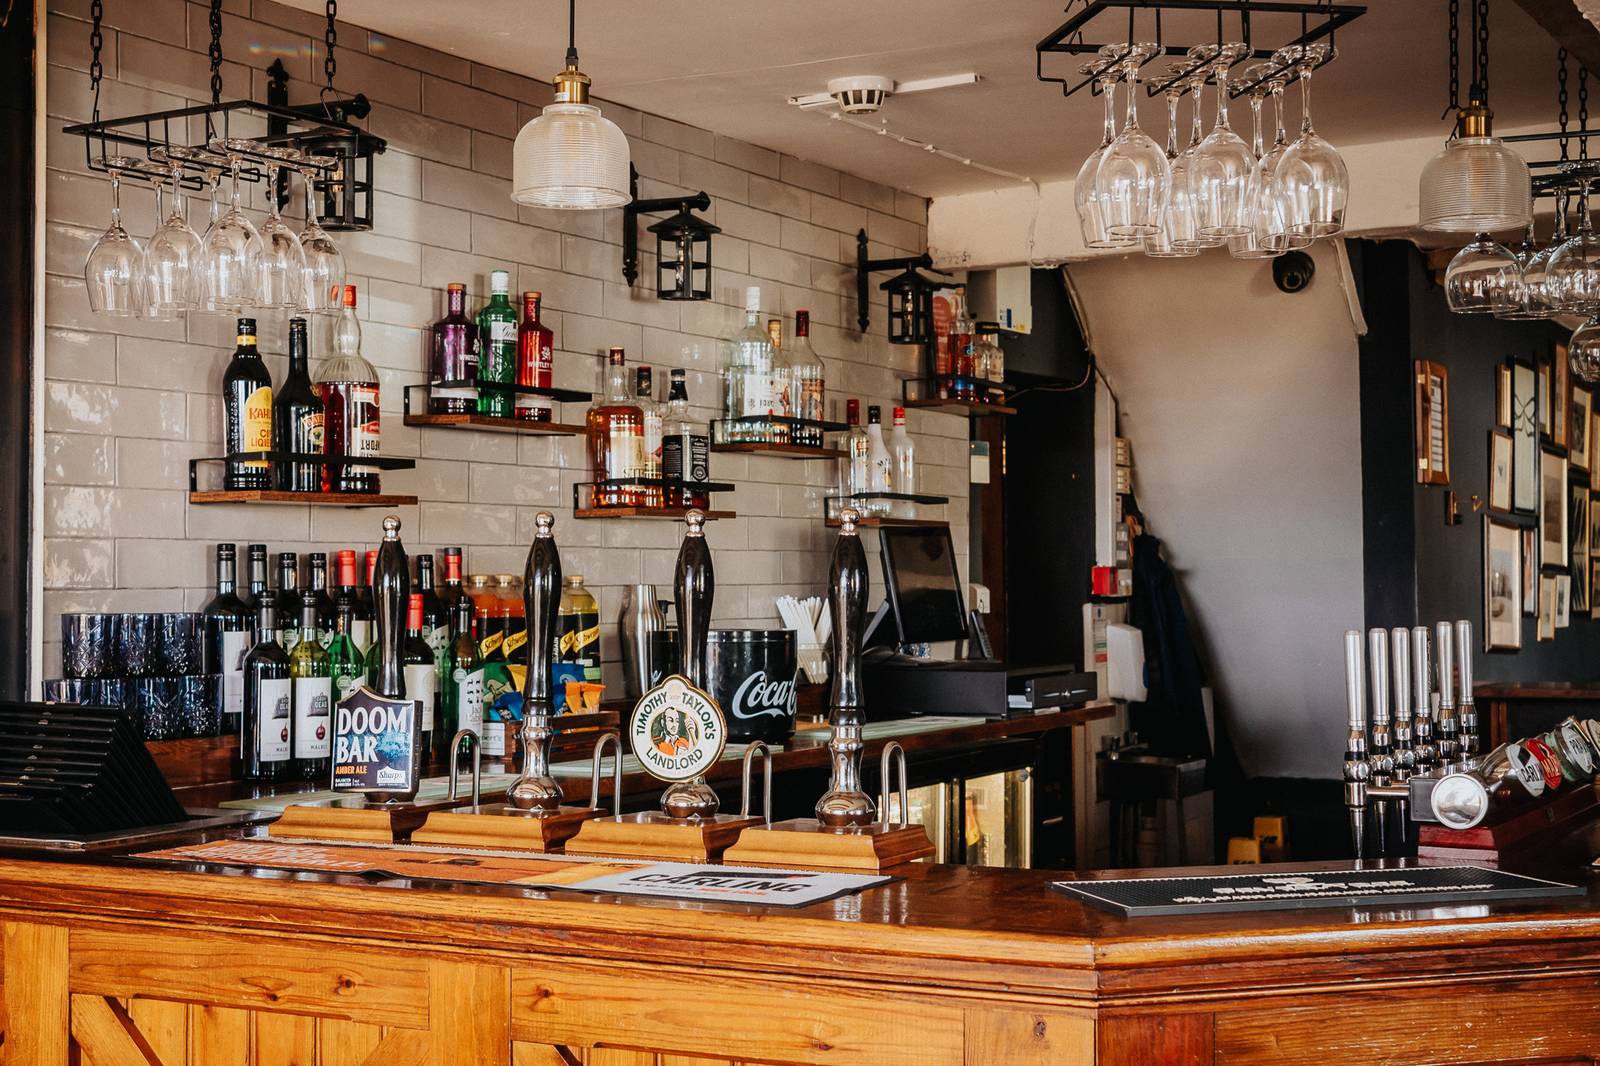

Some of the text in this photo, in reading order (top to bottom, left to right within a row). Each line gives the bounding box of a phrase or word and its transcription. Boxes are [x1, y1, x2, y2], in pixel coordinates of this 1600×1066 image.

[337, 706, 407, 735] DOOM
[636, 691, 715, 740] TIMOTHY TAYLOR'S
[336, 735, 379, 764] BAR
[646, 747, 703, 770] LANDLORD
[335, 765, 368, 775] AMBER ALE
[629, 873, 812, 893] CARLING
